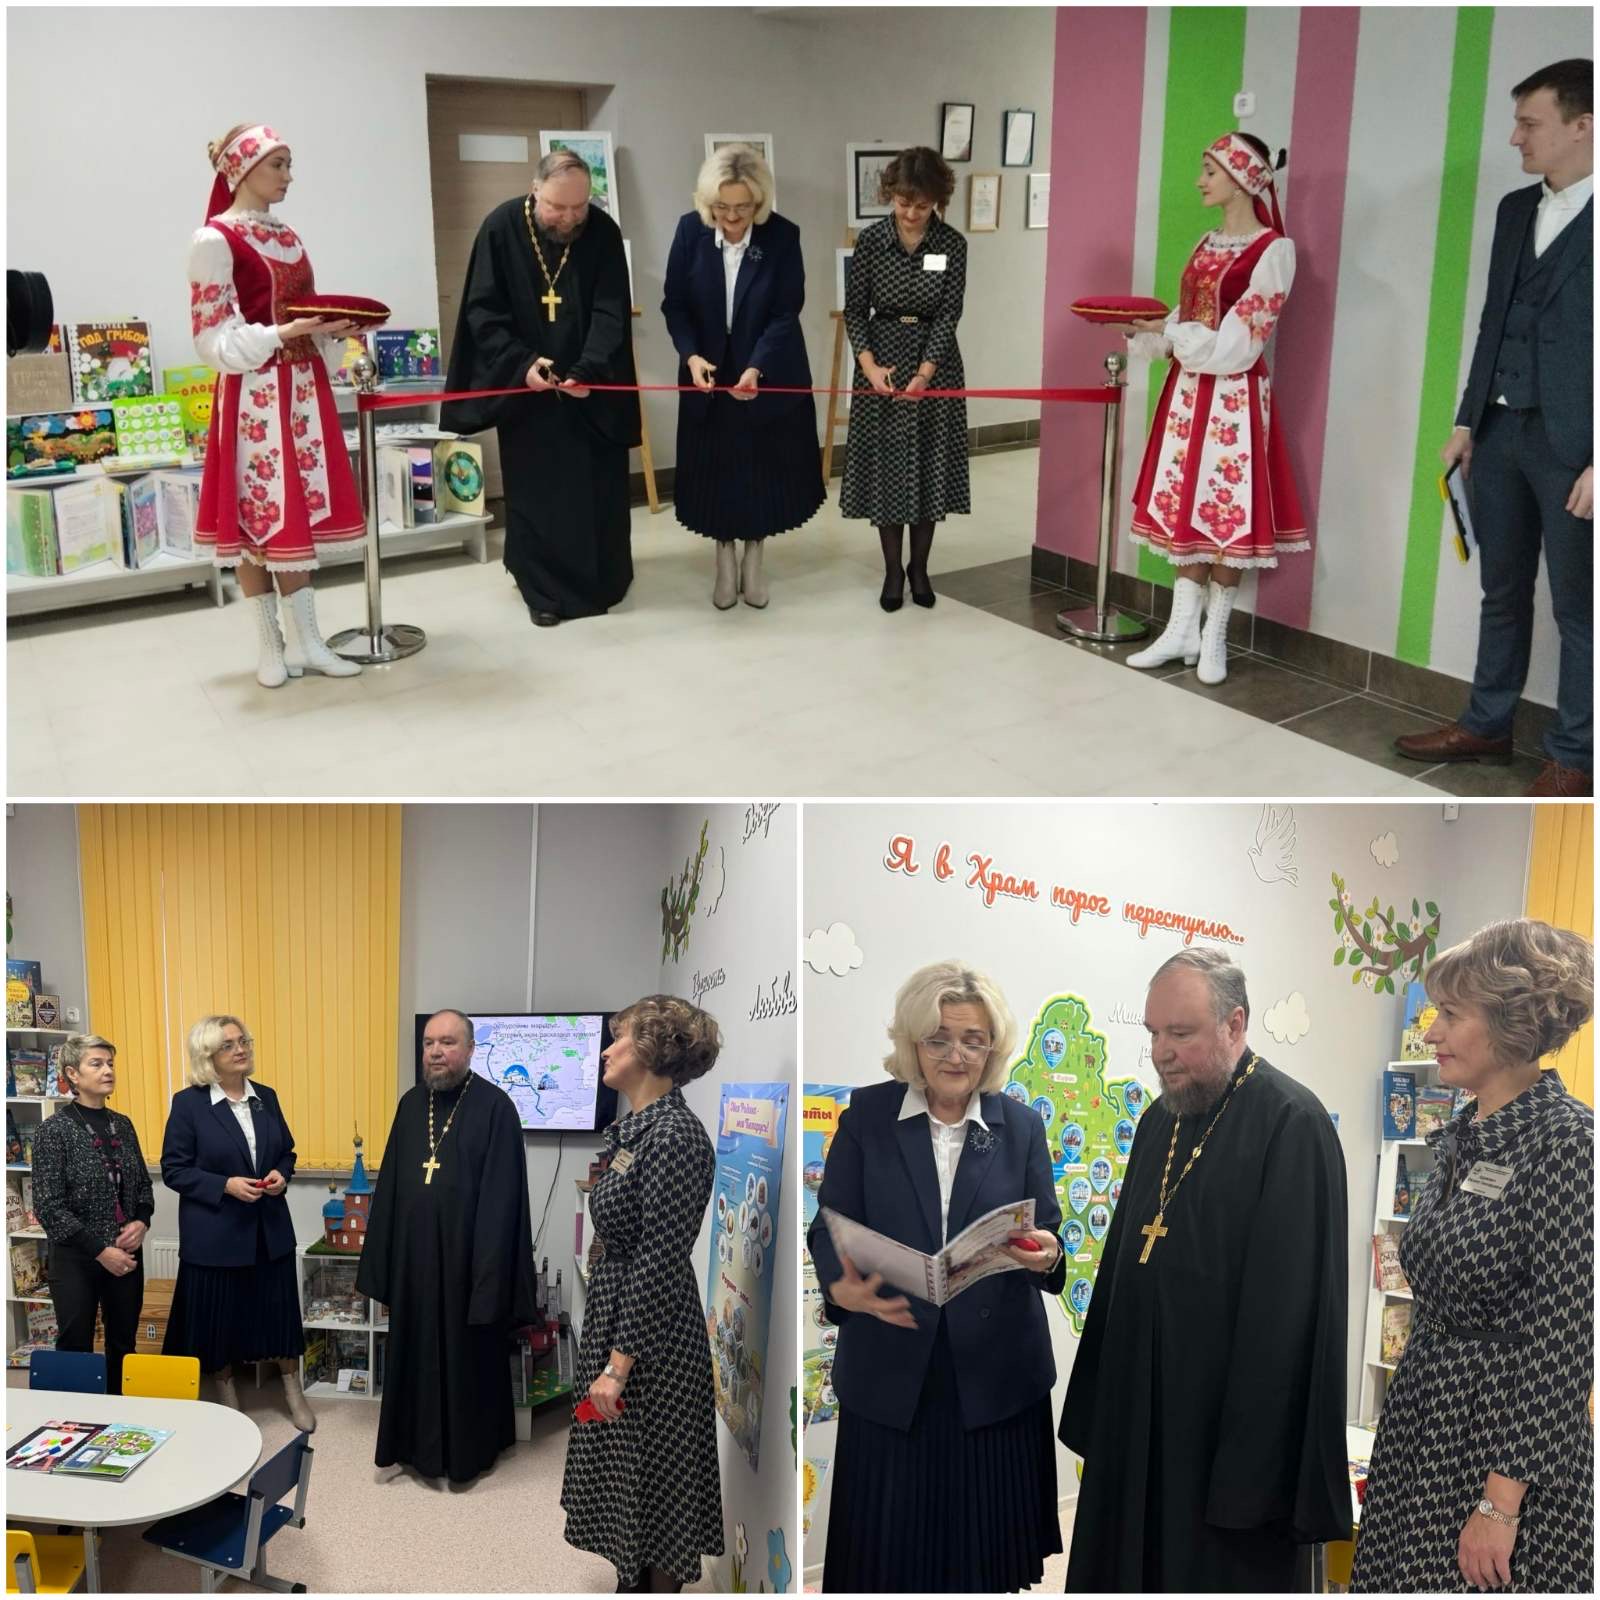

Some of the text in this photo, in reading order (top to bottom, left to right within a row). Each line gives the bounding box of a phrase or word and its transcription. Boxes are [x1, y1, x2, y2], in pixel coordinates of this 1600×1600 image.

[80, 330, 149, 348] ПОД ГРИБОМ
[885, 834, 1246, 946] Я в Храм порог переступлю...
[749, 970, 798, 1022] Любовь
